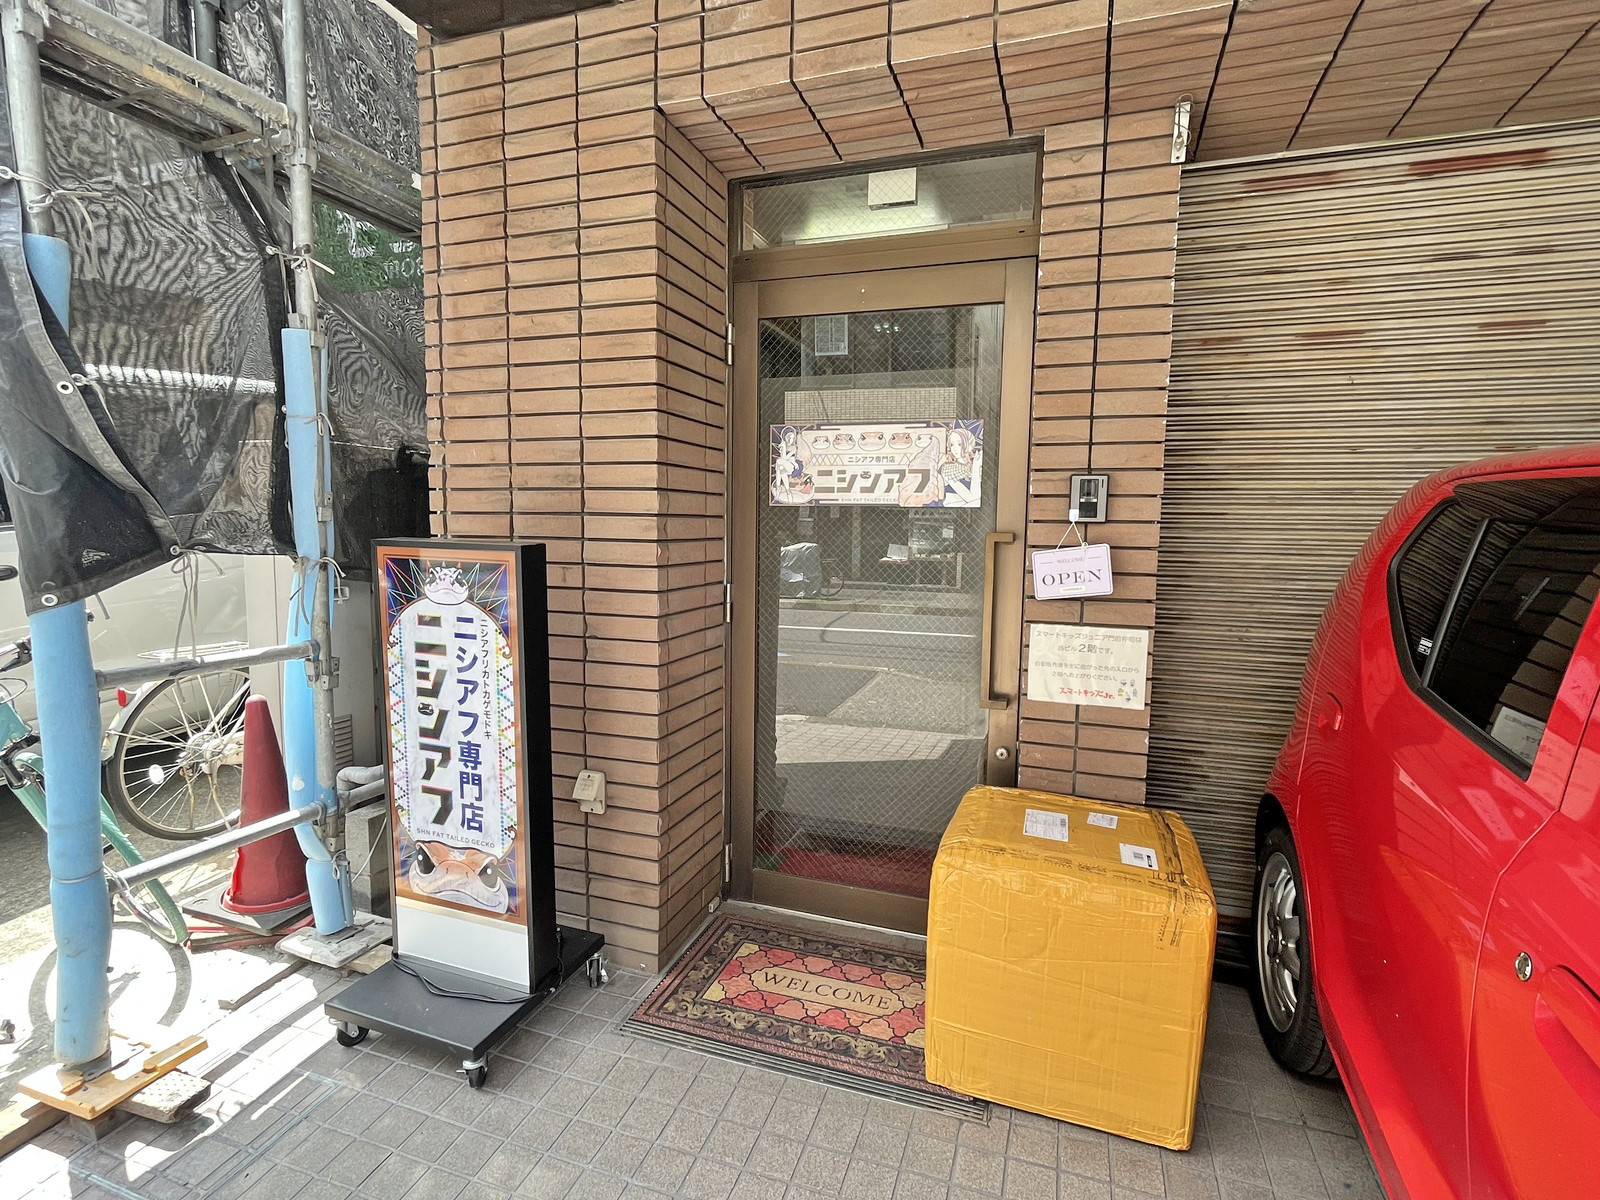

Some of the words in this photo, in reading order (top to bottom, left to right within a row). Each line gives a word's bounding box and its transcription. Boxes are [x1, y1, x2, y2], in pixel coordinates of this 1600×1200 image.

[847, 455, 896, 464] ニシアフ専門店
[1042, 569, 1102, 586] OPEN
[480, 618, 492, 740] ニシアフリカトカゲモドキ
[454, 616, 484, 833] ニシアフ専門店
[416, 827, 431, 836] SHN
[432, 830, 444, 839] FAT
[446, 833, 470, 844] TAILED
[471, 838, 496, 849] GECKO
[764, 971, 893, 1010] WELCOME
